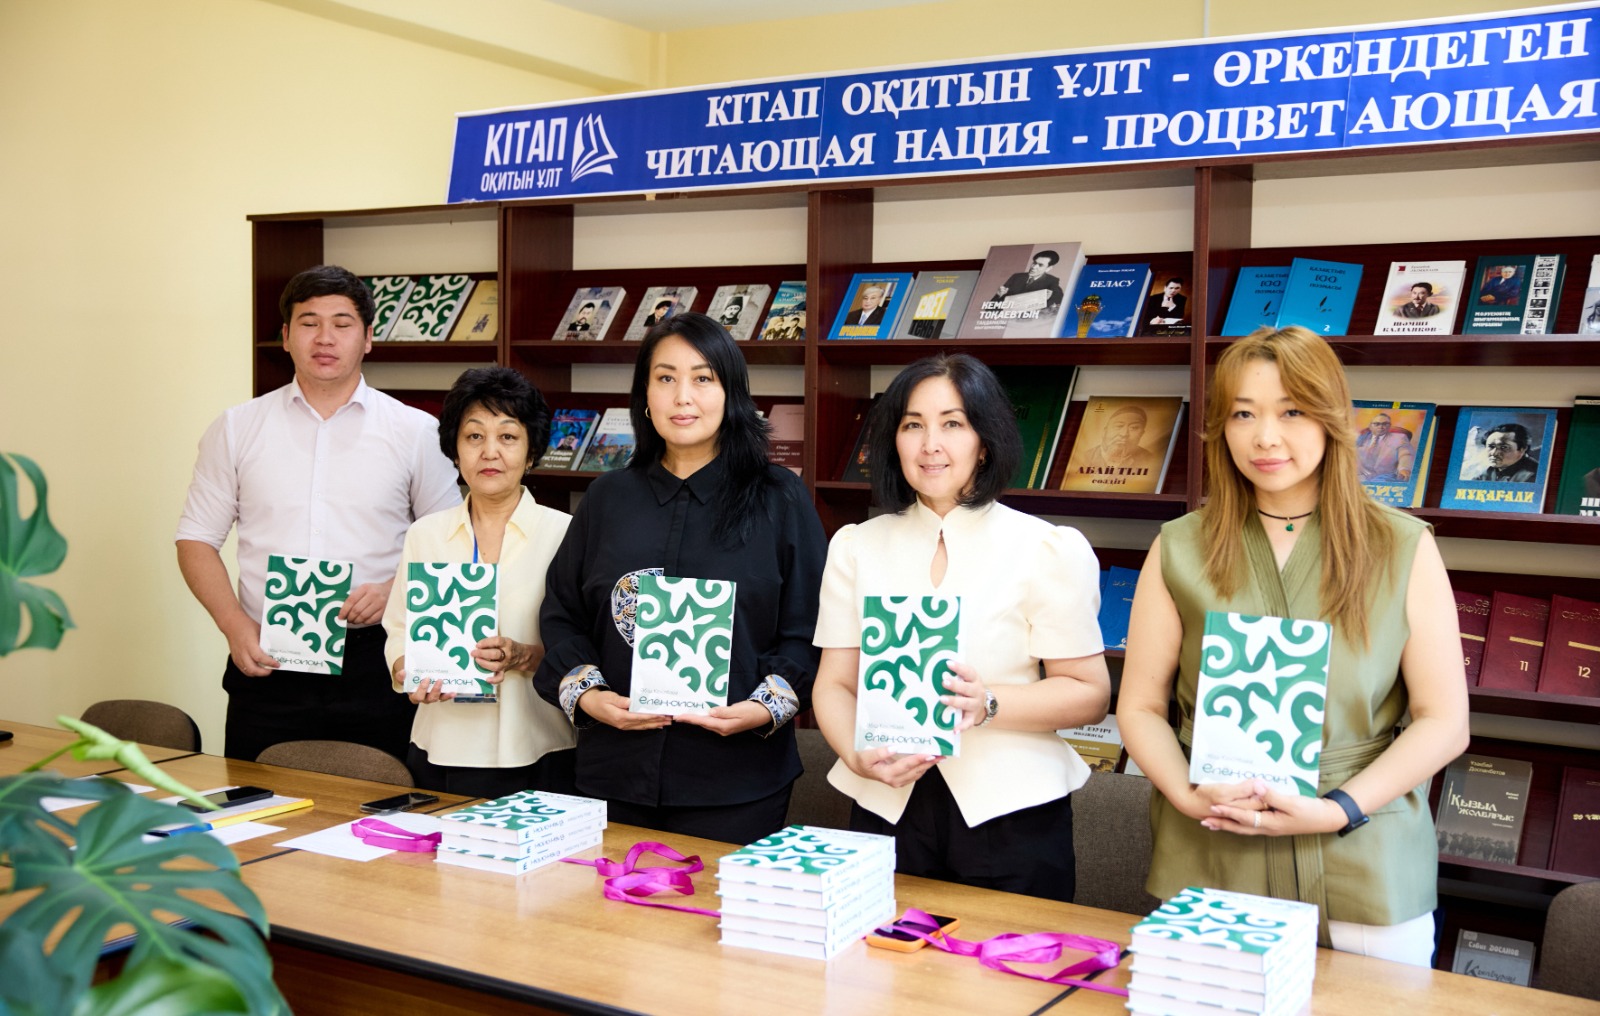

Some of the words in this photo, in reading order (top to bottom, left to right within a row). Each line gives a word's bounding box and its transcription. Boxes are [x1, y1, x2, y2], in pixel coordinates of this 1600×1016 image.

[705, 86, 820, 128] КІТАП
[841, 68, 1031, 119] ОҚИТЫН
[1053, 57, 1151, 99] ҰЛТ
[1173, 73, 1190, 82] -
[1213, 18, 1593, 88] ӨРКЕНДЕГЕН
[483, 117, 568, 167] КІТАП
[645, 132, 877, 179] ЧИТАЮЩАЯ
[894, 119, 1053, 167] НАЦИЯ
[1072, 135, 1088, 143] -
[480, 171, 534, 193] ОҚИТЫН
[537, 169, 562, 190] ҰЛТ
[1089, 280, 1135, 288] БЕЛАСУ
[1315, 275, 1337, 283] 100
[981, 301, 1014, 309] КЕМЕЛ
[980, 310, 1040, 320] ТОҚАЕВТЫҢ
[1323, 324, 1331, 332] 2
[1078, 466, 1115, 475] АБАЙ
[1118, 467, 1149, 476] ТІЛІ
[1519, 660, 1529, 672] 11
[1577, 666, 1591, 678] 12
[1489, 944, 1520, 956] ДОСАНОВ
